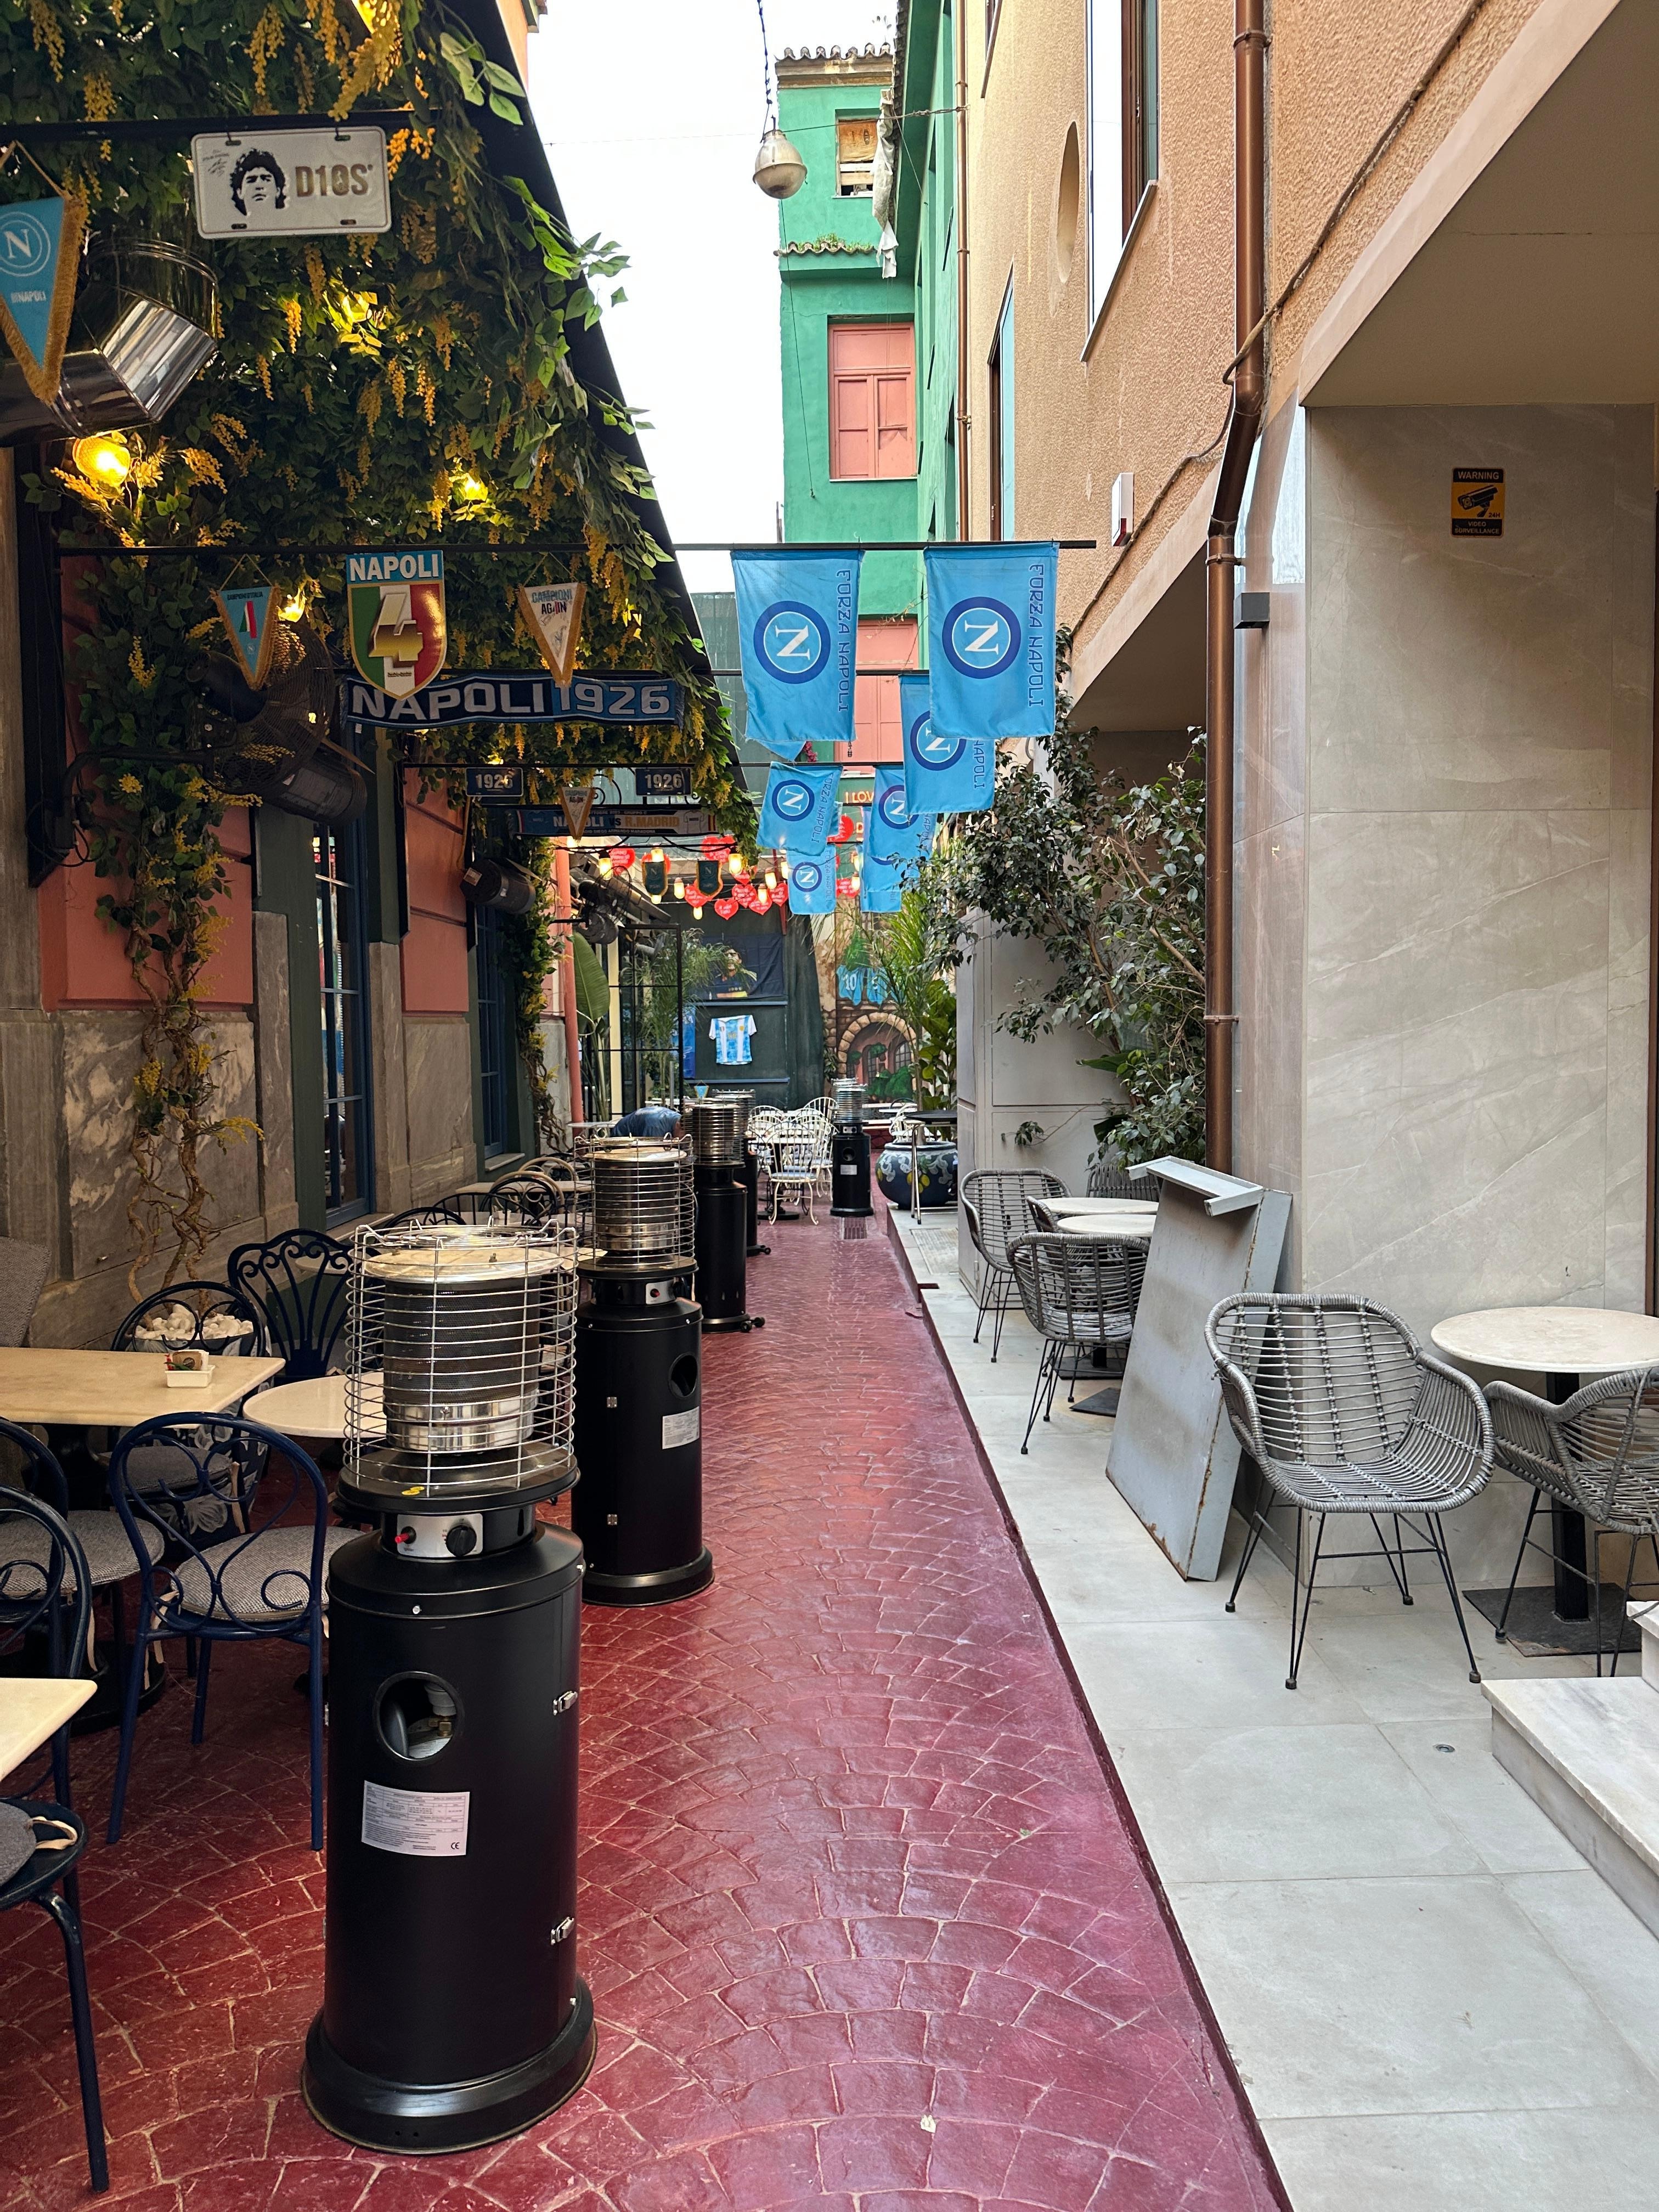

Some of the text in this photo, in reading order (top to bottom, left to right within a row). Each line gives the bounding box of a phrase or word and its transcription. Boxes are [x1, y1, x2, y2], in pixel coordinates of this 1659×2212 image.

[4, 228, 31, 258] N
[1458, 471, 1499, 480] WARNING
[349, 554, 439, 582] NAPOLI
[369, 593, 423, 668] 4
[775, 625, 810, 661] N
[836, 569, 851, 712] FORZA NAPOLI
[964, 620, 999, 655] N
[1028, 564, 1044, 707] FORZA NAPOLI
[352, 682, 670, 720] NAPOLI 1926
[476, 774, 513, 789] 1926
[645, 774, 682, 789] 1926
[782, 788, 805, 811] N
[852, 791, 874, 803] LOV
[625, 816, 680, 828] R.MADRID
[843, 974, 857, 991] 10
